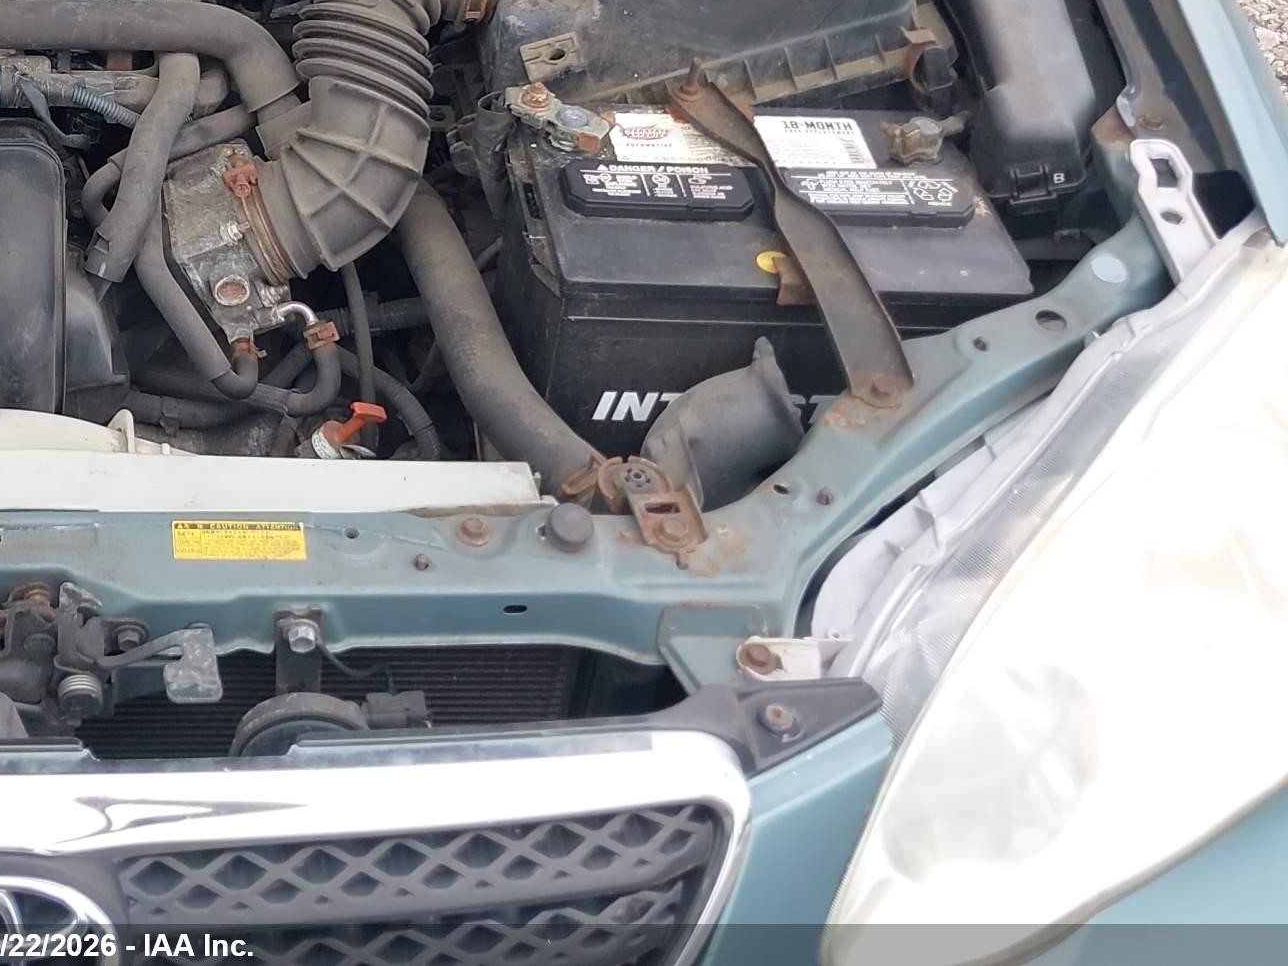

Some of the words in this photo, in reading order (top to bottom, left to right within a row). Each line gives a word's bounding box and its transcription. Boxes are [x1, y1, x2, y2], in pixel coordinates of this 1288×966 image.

[782, 120, 853, 131] 18-MONTH
[609, 164, 655, 174] DANGER
[666, 166, 709, 174] POISON
[1053, 173, 1065, 184] B
